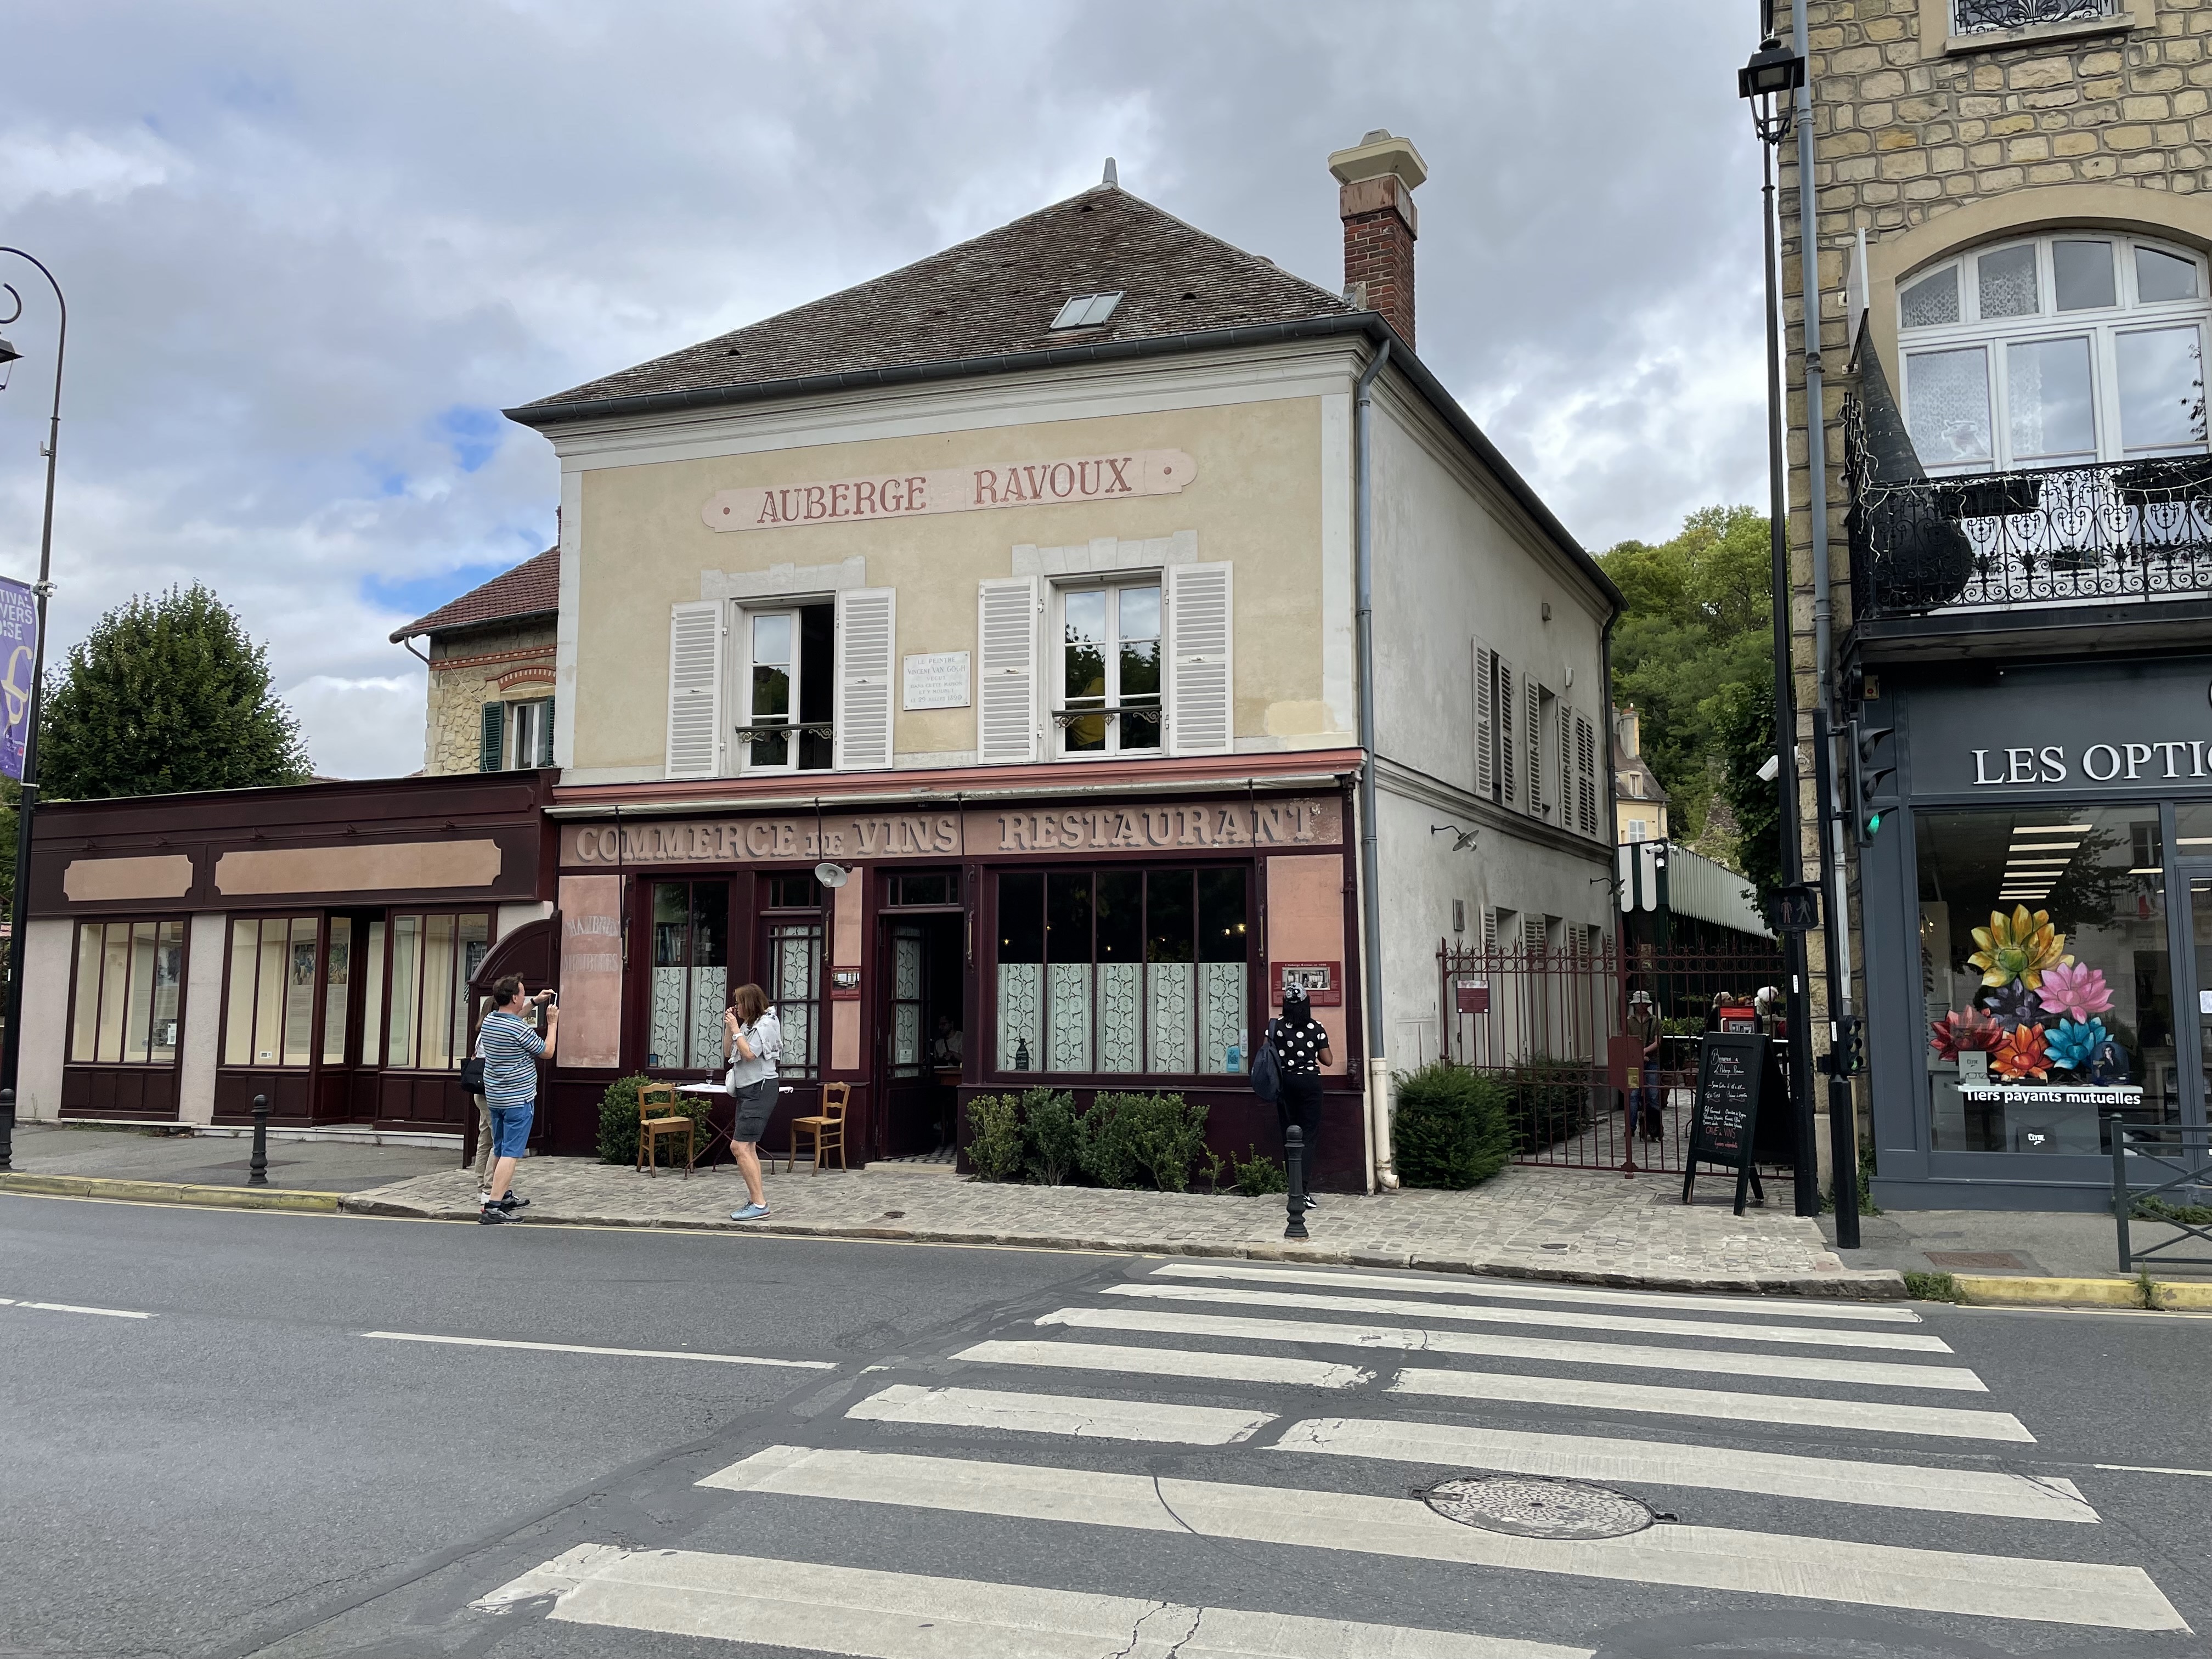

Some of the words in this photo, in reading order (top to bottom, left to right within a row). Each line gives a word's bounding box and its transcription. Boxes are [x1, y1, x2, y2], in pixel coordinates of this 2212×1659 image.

[757, 476, 927, 524] AUBERGE
[973, 457, 1132, 505] RAVOUX
[0, 619, 22, 641] ISE
[946, 664, 966, 673] GOGH
[1971, 745, 2068, 785] LES
[2082, 740, 2212, 782] OPTI
[575, 821, 798, 862] COMMERCE
[805, 831, 845, 856] DE
[853, 815, 958, 854] VINS
[998, 802, 1321, 851] RESTAURANT
[1965, 1089, 2000, 1101] Tiers
[2004, 1091, 2062, 1104] payants
[2066, 1092, 2141, 1105] mutuelles
